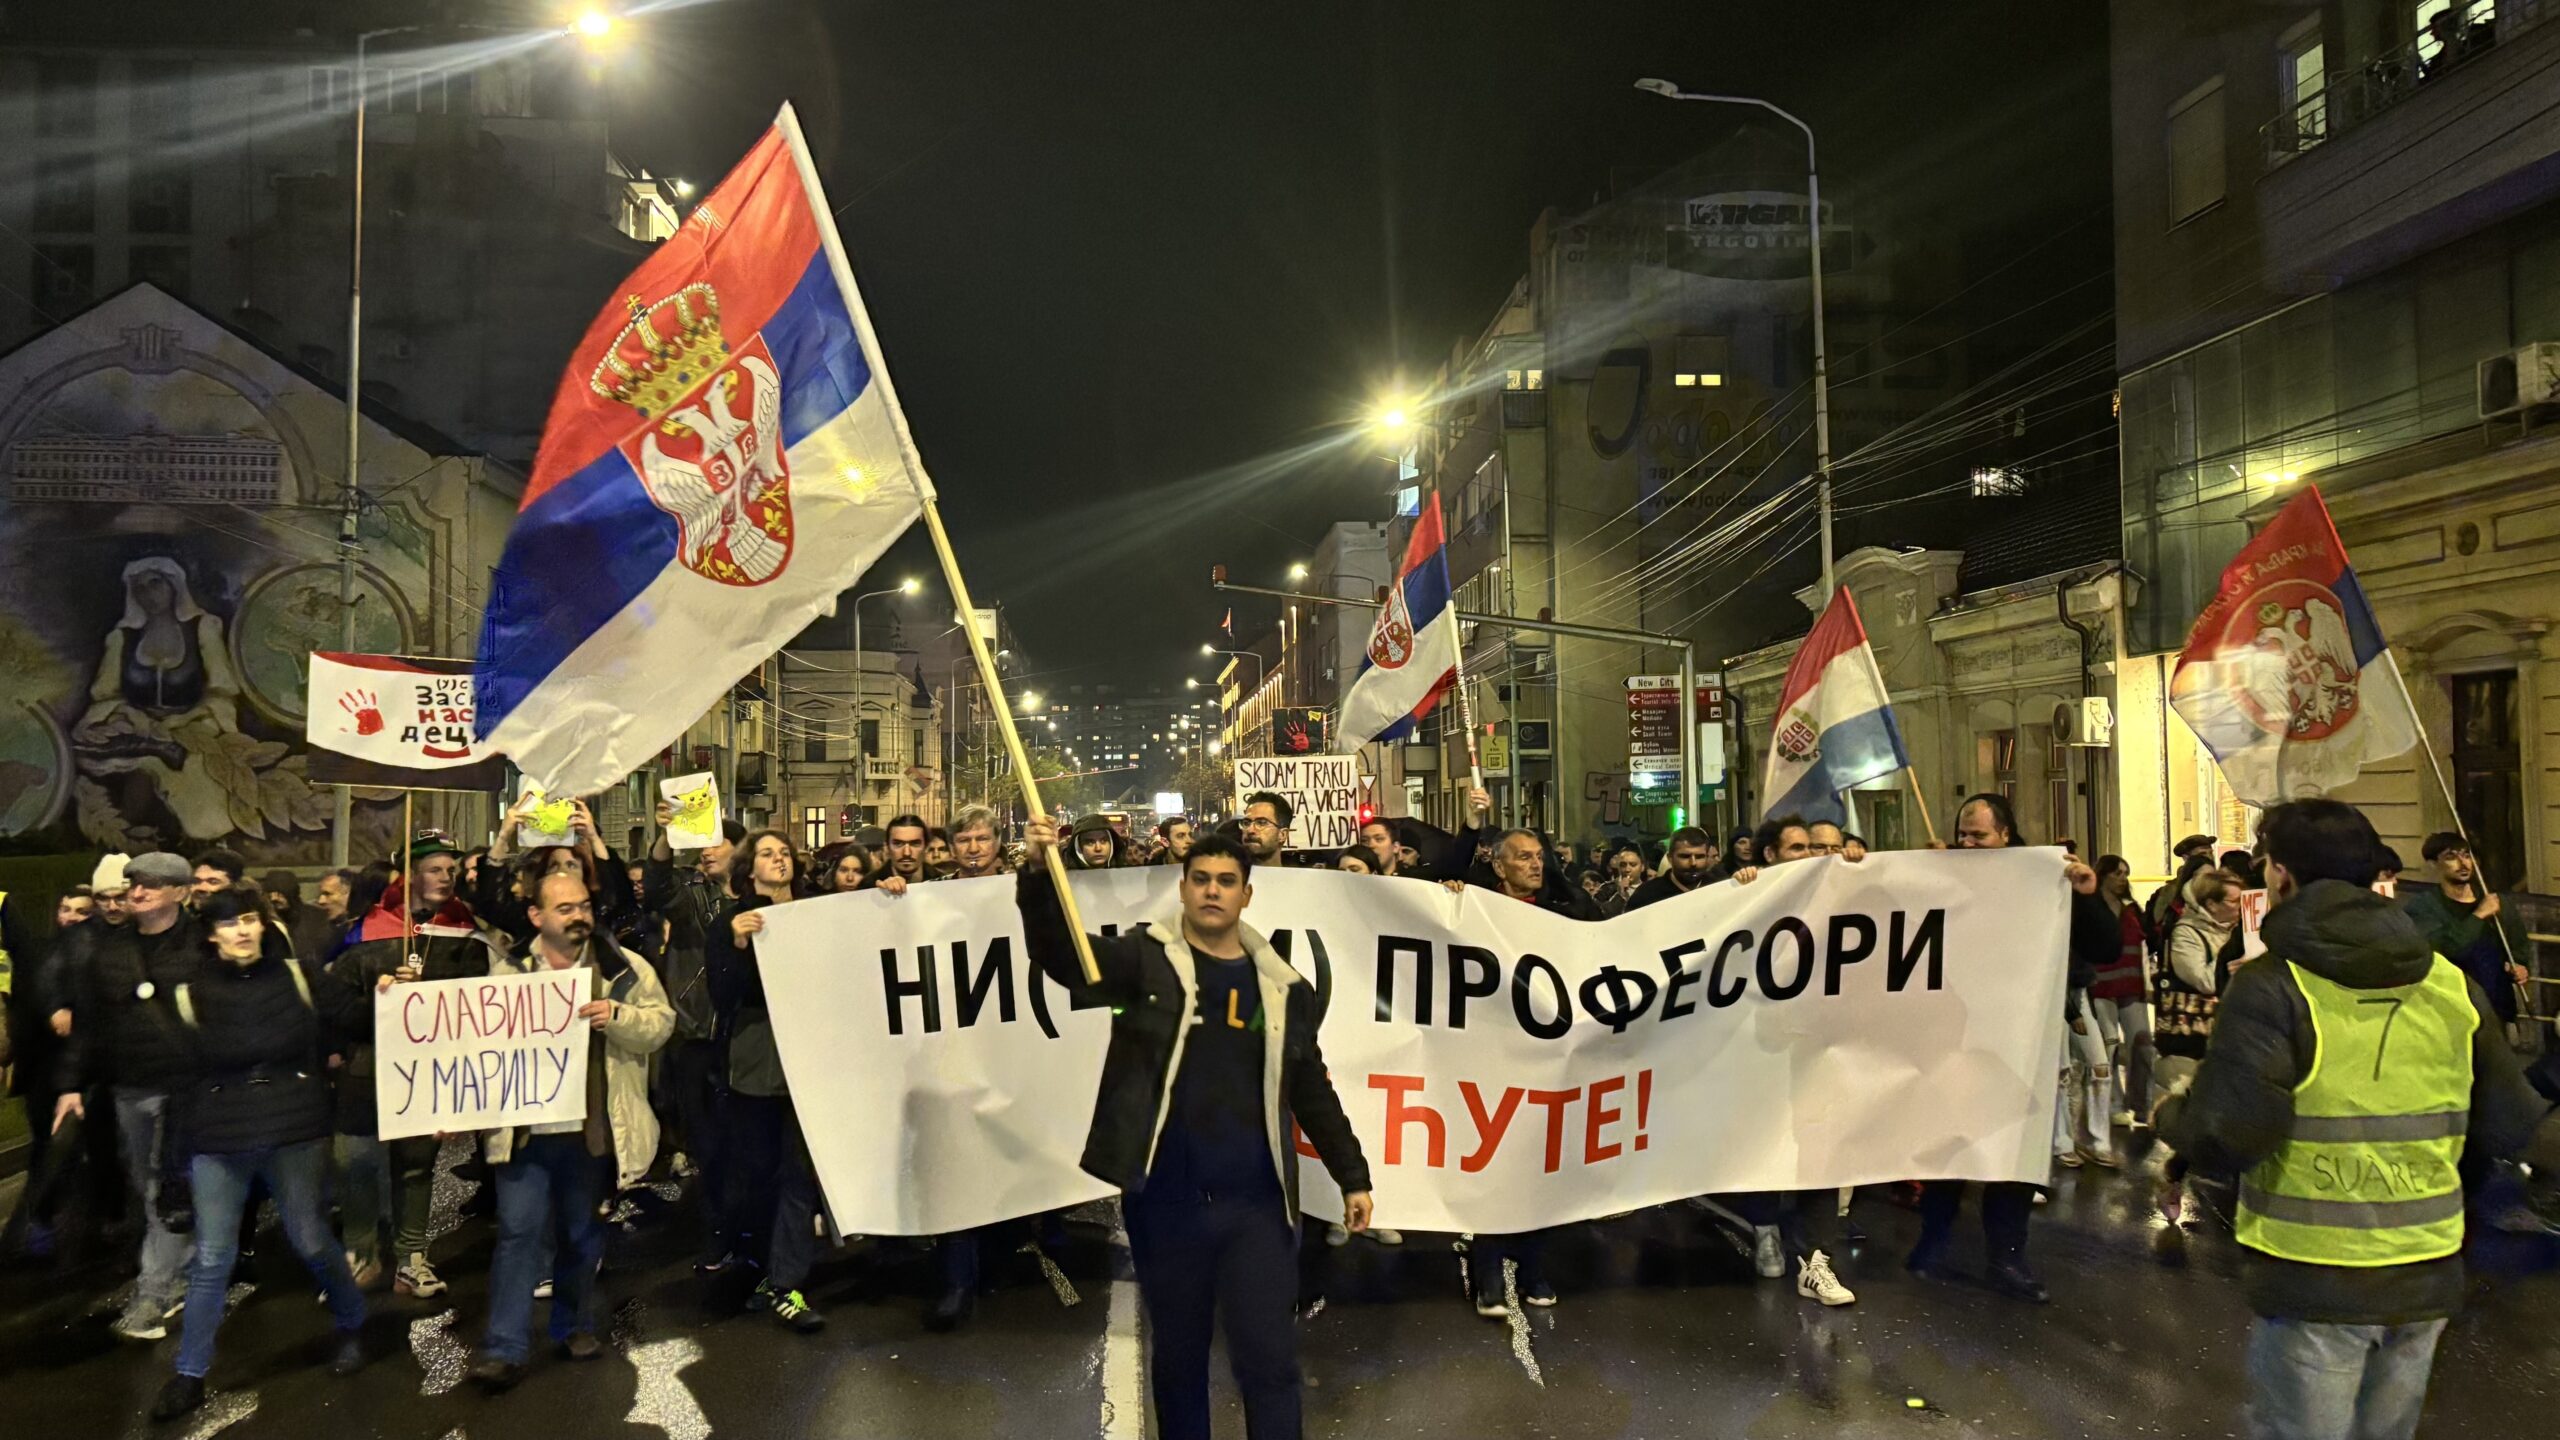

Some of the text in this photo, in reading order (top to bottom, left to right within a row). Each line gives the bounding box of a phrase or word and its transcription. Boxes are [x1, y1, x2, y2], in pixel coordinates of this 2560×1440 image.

[1638, 677, 1674, 688] New City
[1240, 761, 1350, 789] SKIDAM TRAKU
[1315, 788, 1357, 813] VICEM
[1305, 814, 1360, 848] VLADA
[1375, 907, 1946, 1040] ПРОФЕСОРИ
[403, 978, 577, 1044] СЛАВИЦУ
[2356, 997, 2403, 1082] 7
[393, 1047, 569, 1116] У МАРИЦУ
[1367, 1068, 1654, 1175] ЋУТЕ!
